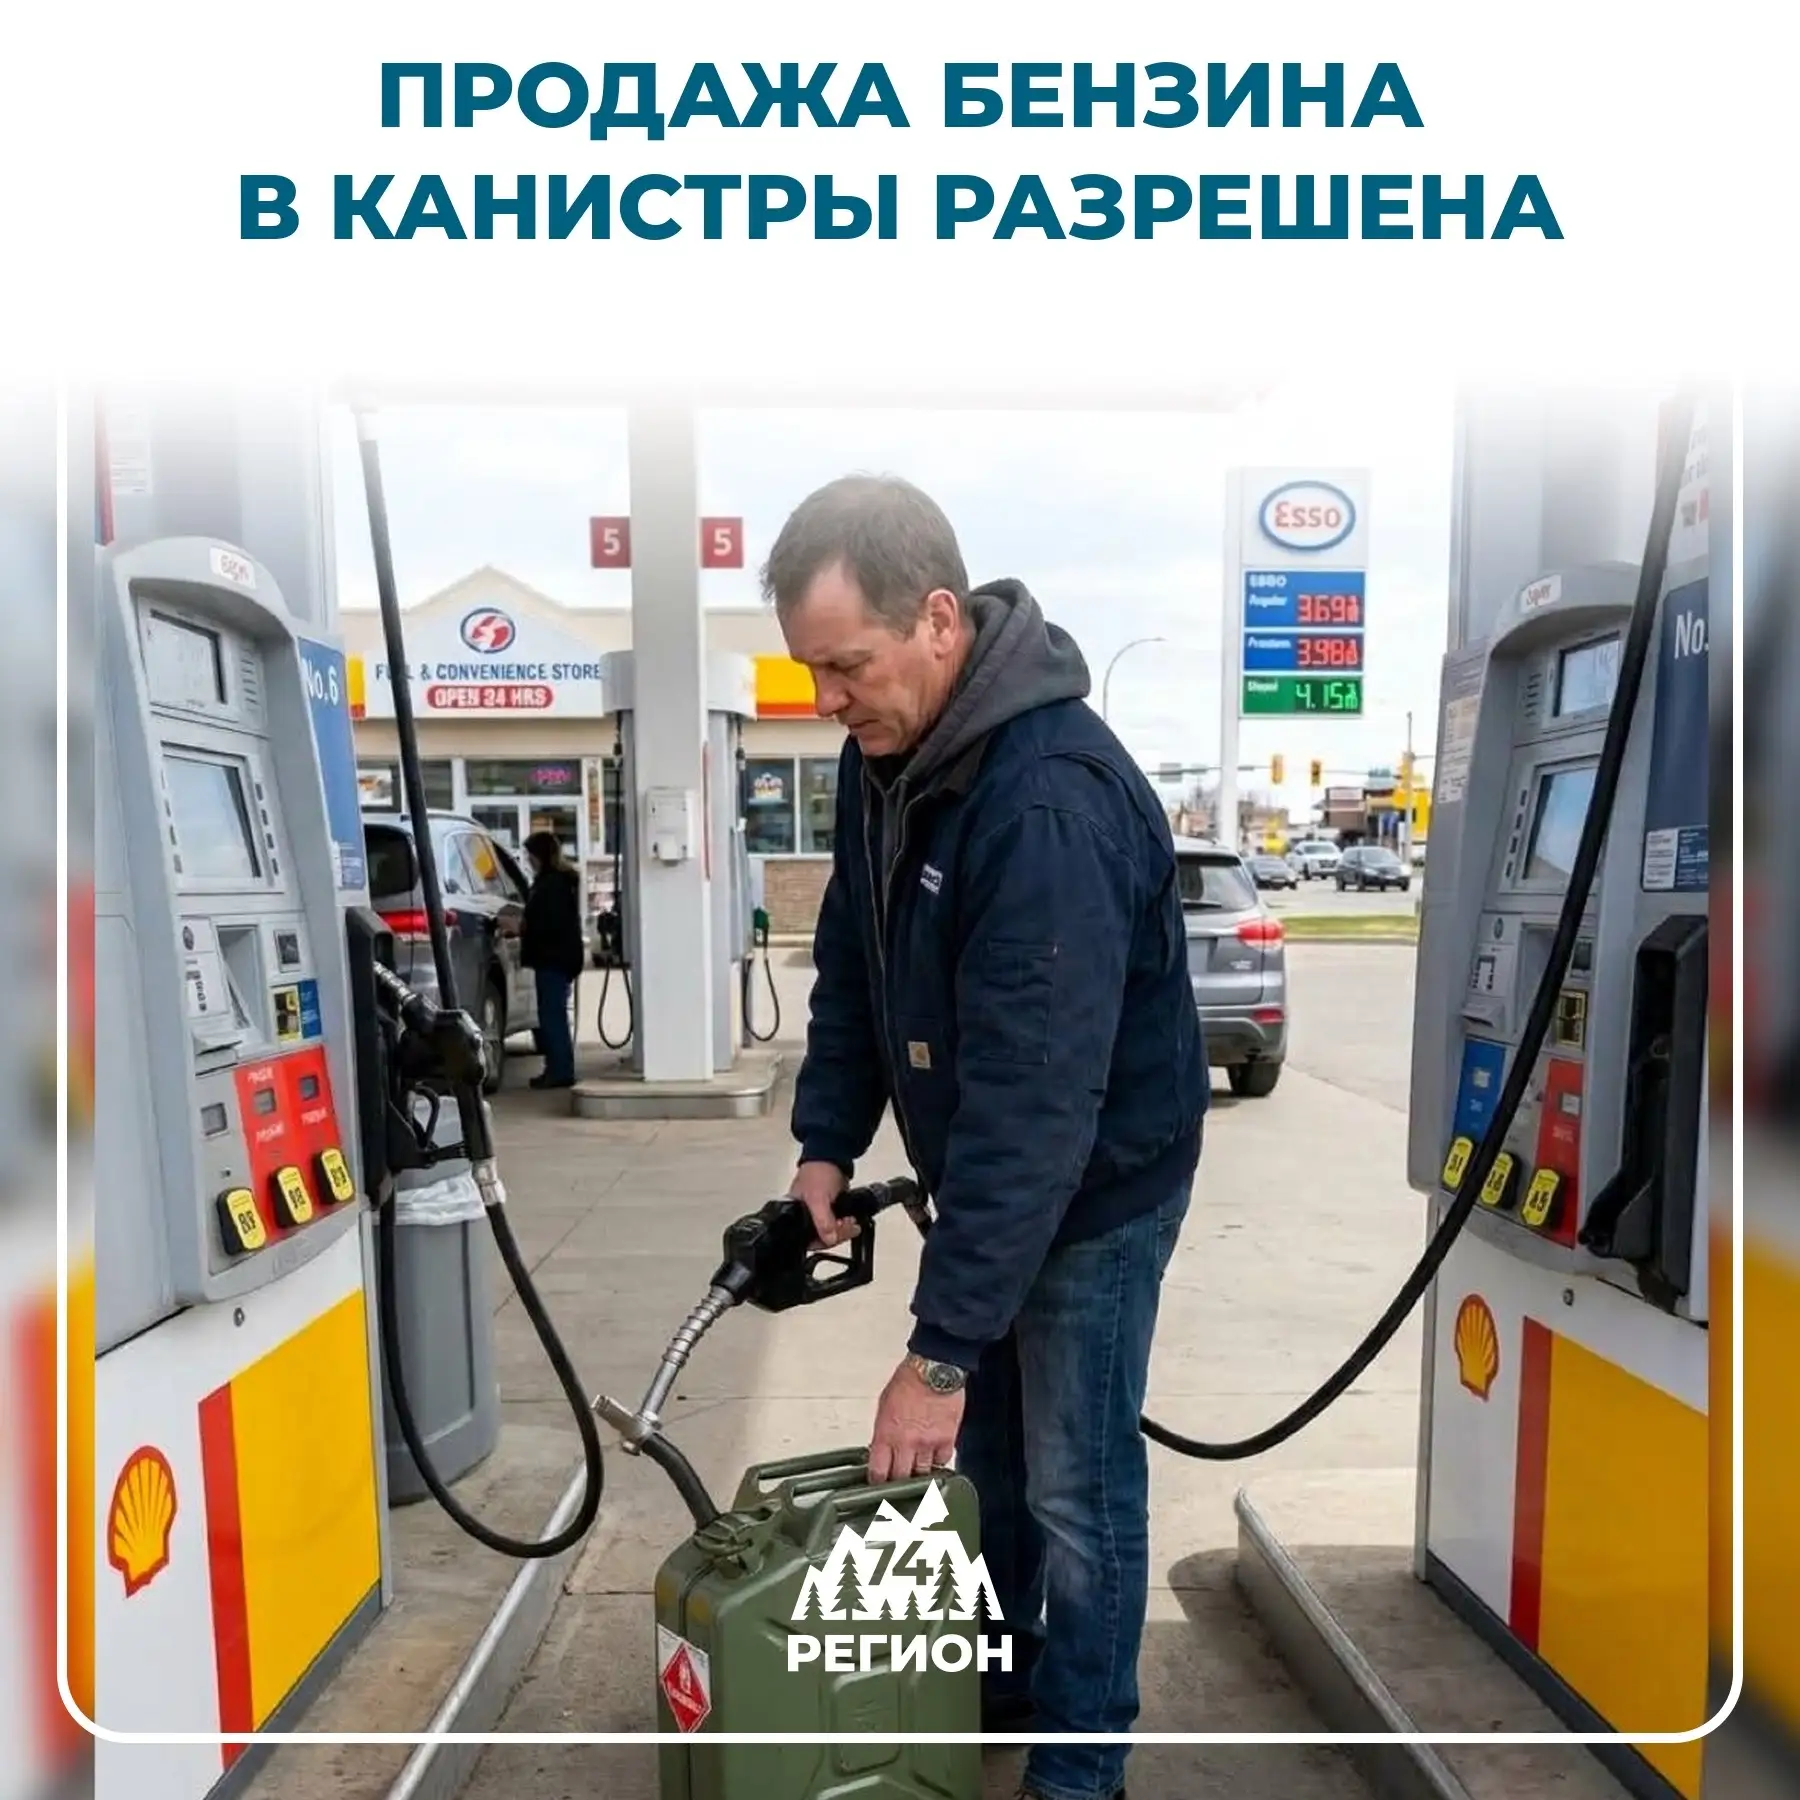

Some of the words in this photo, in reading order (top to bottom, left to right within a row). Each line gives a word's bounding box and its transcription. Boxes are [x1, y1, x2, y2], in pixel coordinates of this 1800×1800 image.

[603, 527, 621, 556] 5
[713, 527, 732, 556] 5
[436, 663, 547, 680] CONVENIENCE
[552, 663, 600, 680] STORE
[435, 687, 481, 707] OPEN
[483, 687, 507, 707] 24
